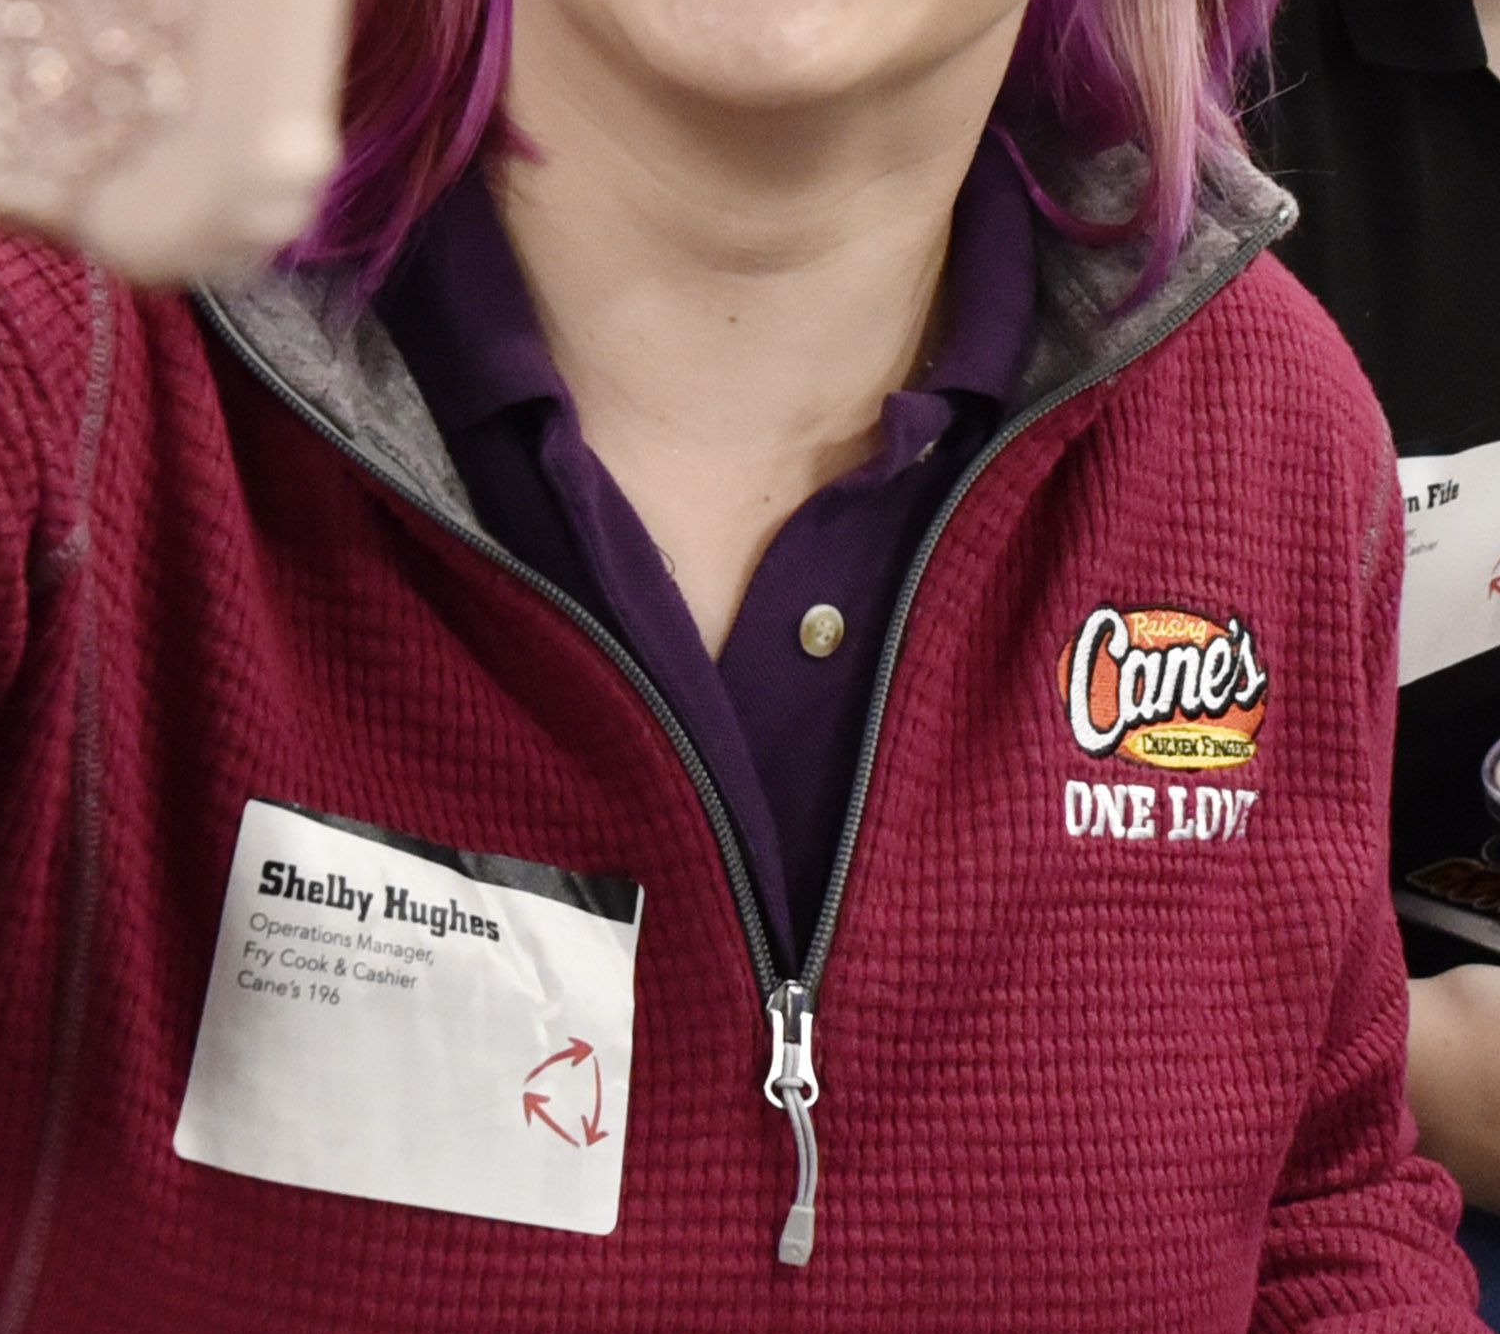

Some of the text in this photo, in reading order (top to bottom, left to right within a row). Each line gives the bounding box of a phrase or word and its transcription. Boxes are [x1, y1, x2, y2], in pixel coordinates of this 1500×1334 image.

[1426, 479, 1461, 511] Fife
[1128, 612, 1208, 644] Raising
[1070, 607, 1267, 752] Cane's
[1142, 733, 1199, 758] CHICKEN
[1064, 780, 1156, 840] ONE
[258, 860, 502, 943] Shelby Hughes
[249, 911, 435, 966] Operations Manager,
[237, 970, 342, 1007] Cane's 196
[243, 941, 419, 990] Fry Cook & Cashier
